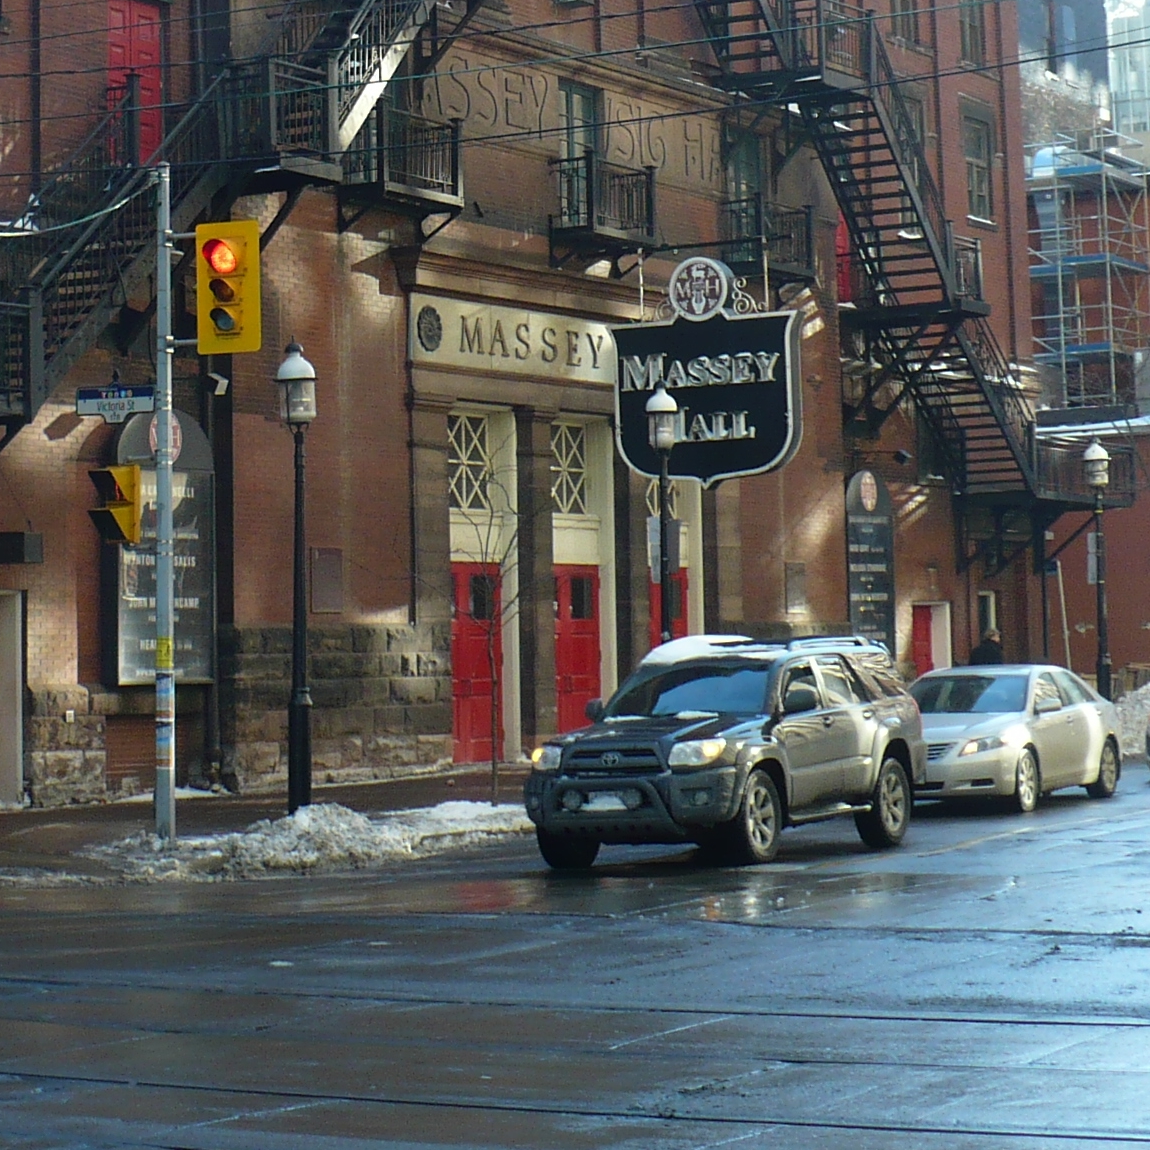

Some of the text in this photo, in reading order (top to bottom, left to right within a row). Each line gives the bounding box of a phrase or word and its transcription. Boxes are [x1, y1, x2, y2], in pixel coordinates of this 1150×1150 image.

[422, 55, 548, 140] ASSEY
[459, 315, 604, 369] MASSEY
[620, 352, 781, 391] MASSEY
[96, 399, 135, 412] Victoria St
